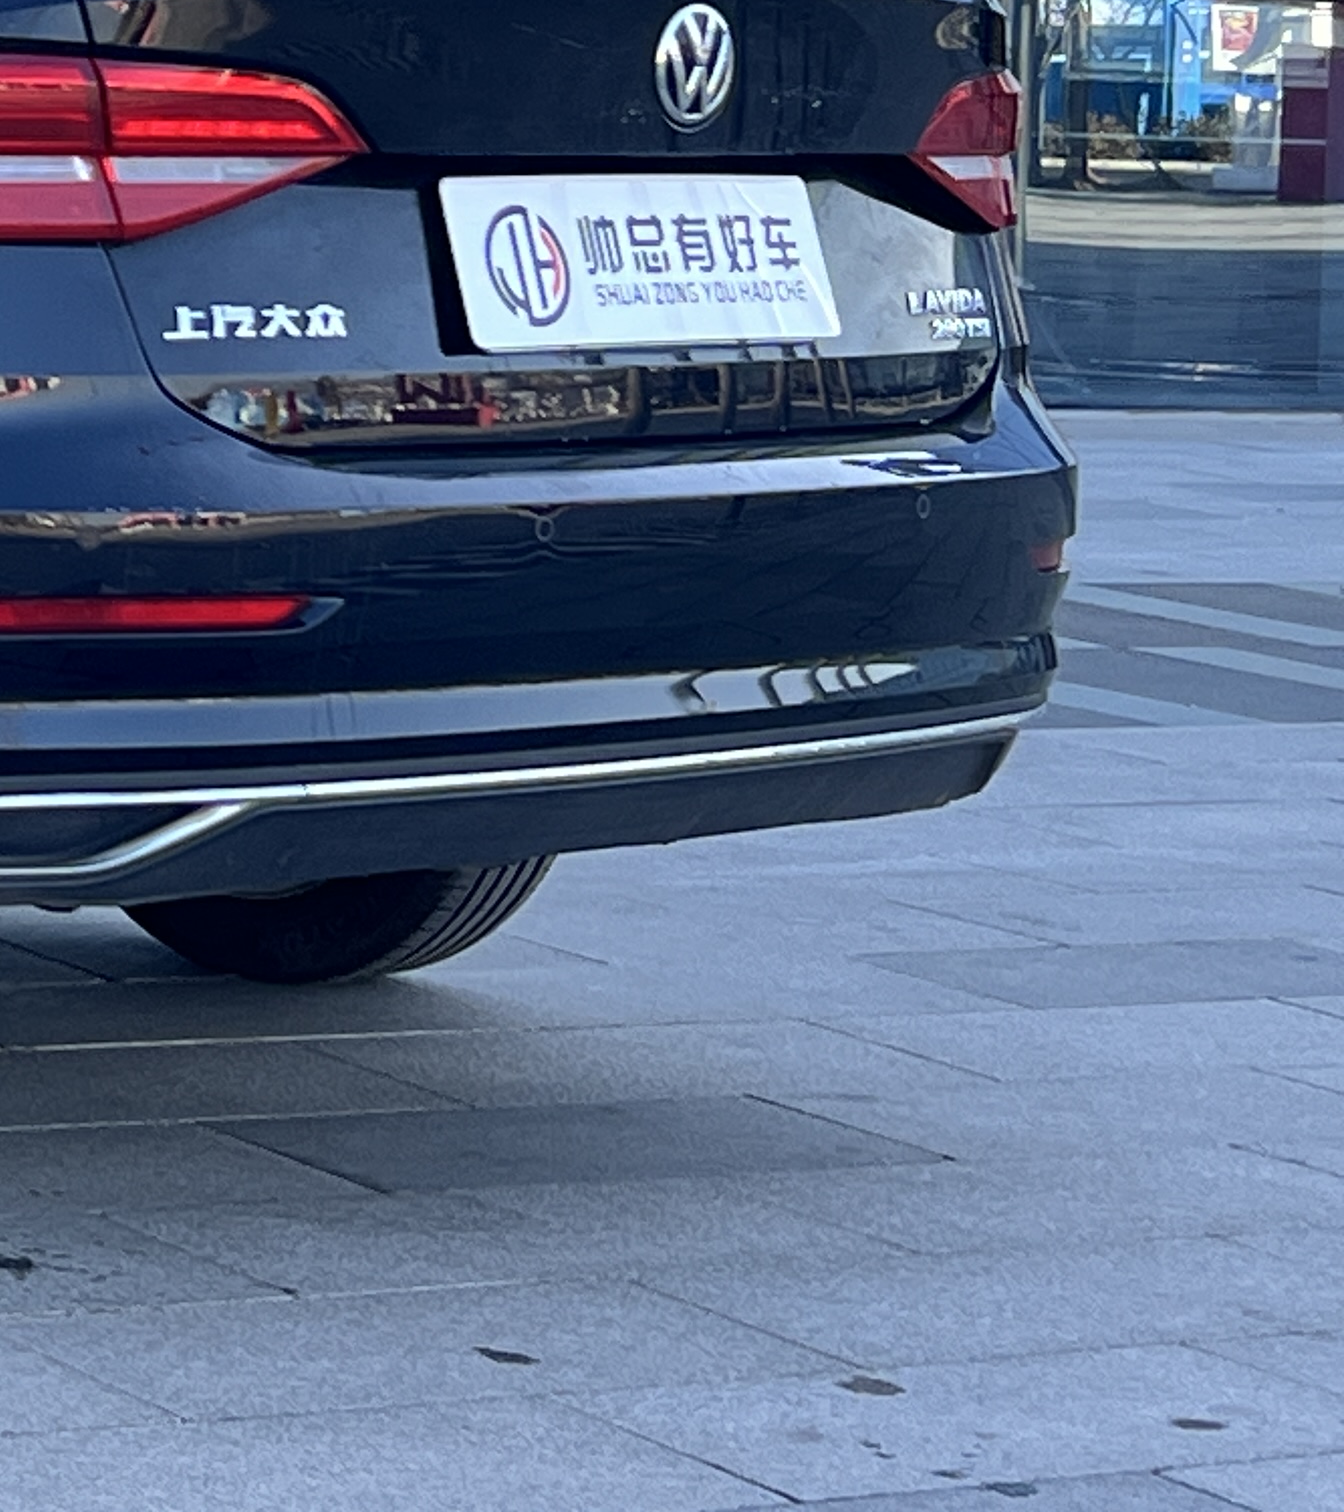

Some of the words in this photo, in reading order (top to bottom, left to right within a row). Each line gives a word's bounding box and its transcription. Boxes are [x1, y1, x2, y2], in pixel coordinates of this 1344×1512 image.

[576, 213, 800, 275] 帅总有好车
[596, 284, 650, 307] SHUAI
[655, 283, 699, 305] ZONG
[703, 282, 737, 303] YOU
[740, 281, 773, 303] HAO
[776, 280, 808, 302] CHE
[906, 288, 987, 316] LAVIDA
[162, 302, 348, 340] 上汽大众
